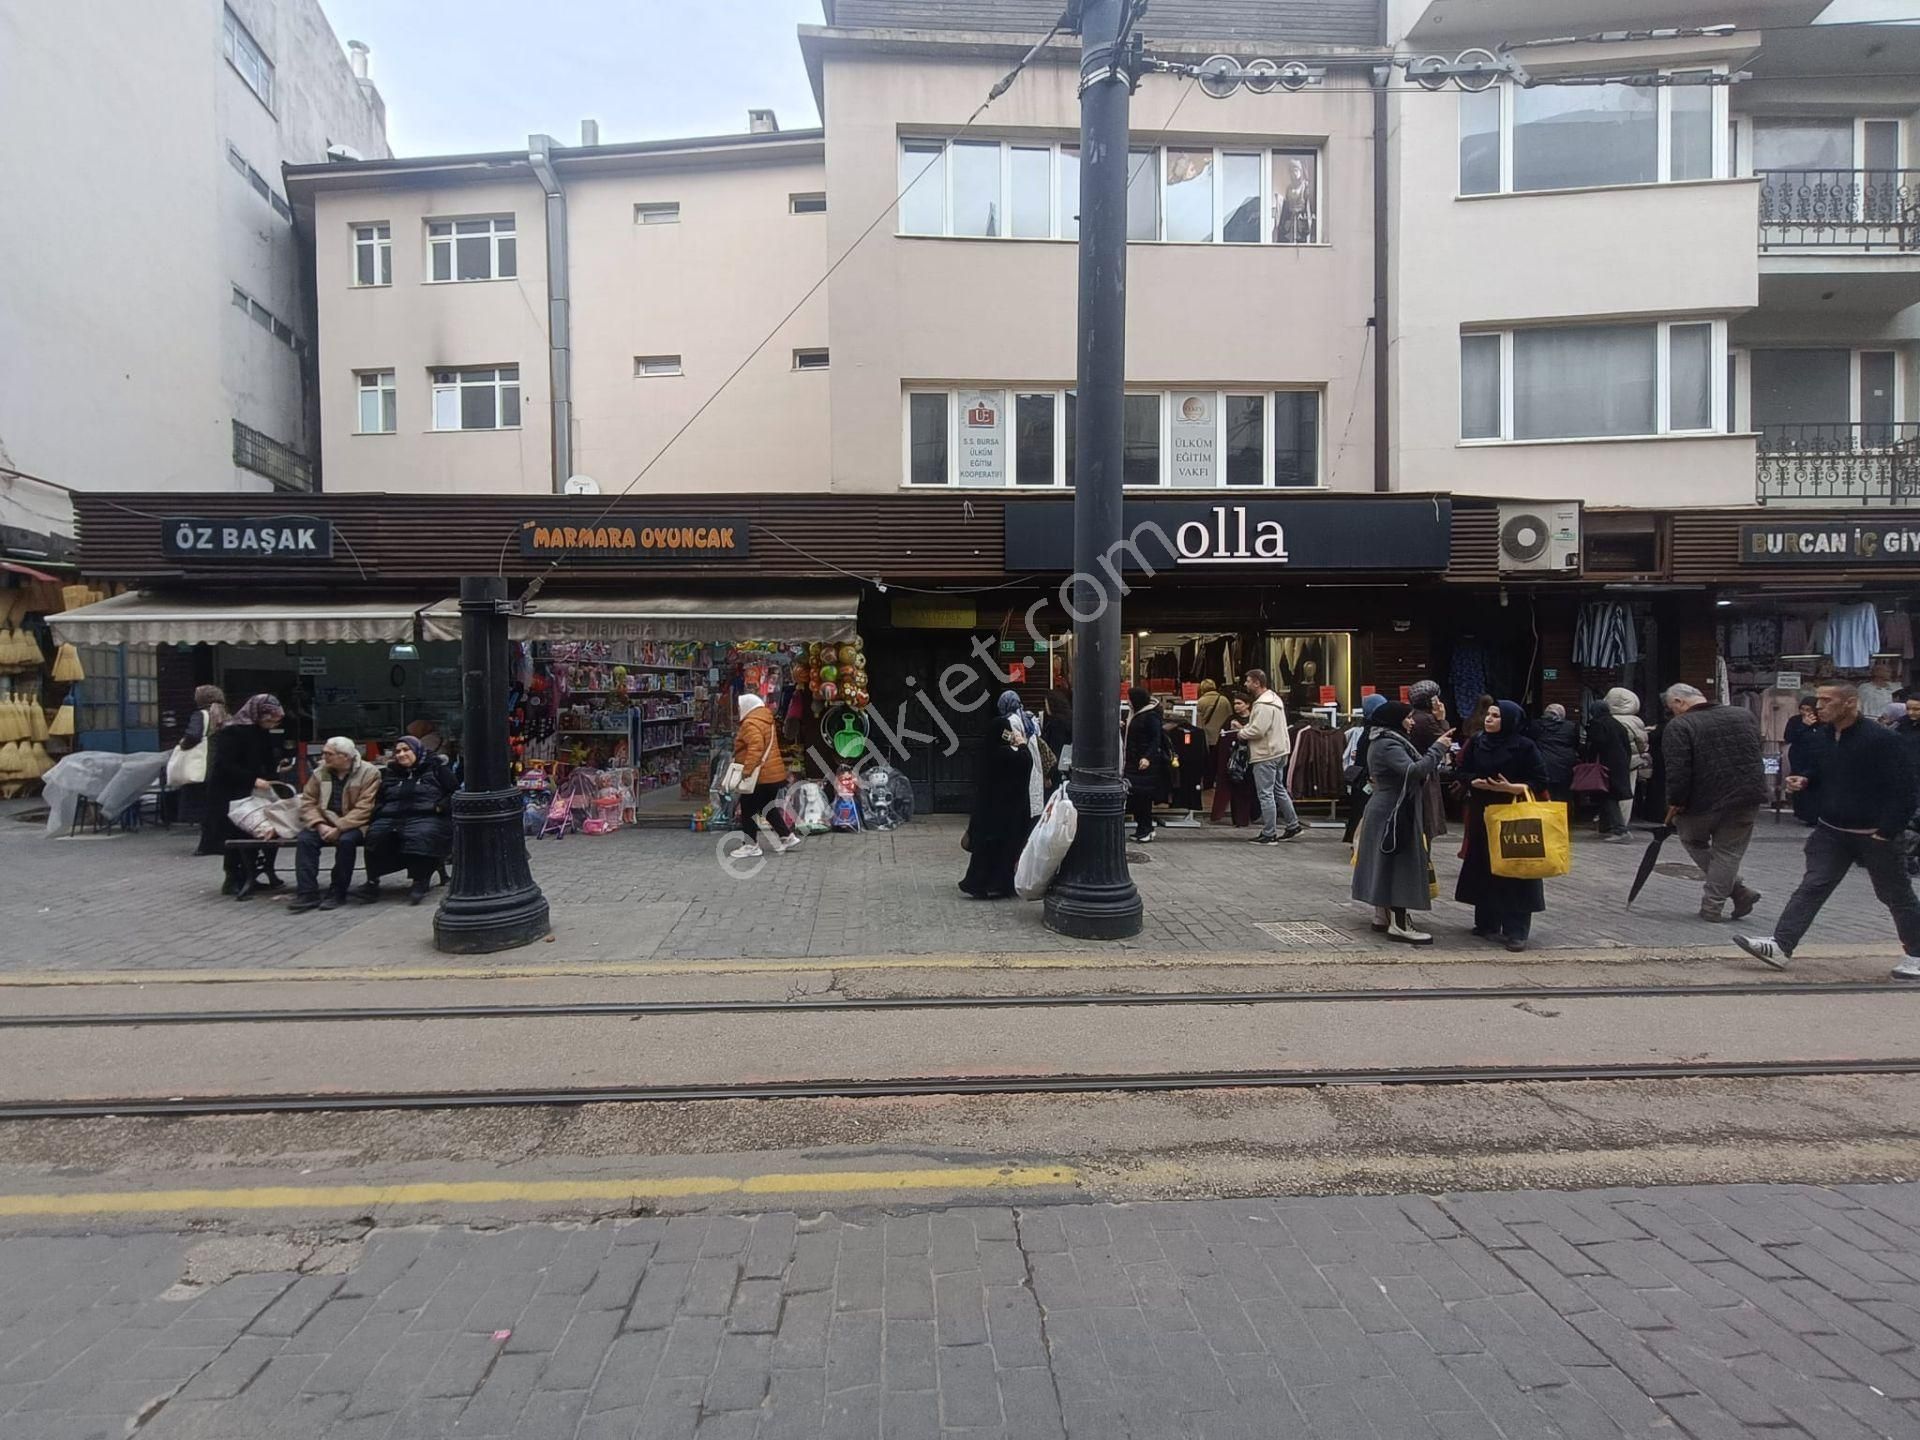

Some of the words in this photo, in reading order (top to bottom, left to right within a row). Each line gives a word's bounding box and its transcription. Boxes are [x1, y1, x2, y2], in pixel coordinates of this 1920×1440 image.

[1175, 438, 1212, 448] ÜLKÜM
[970, 447, 993, 456] ÜLKÜM
[1176, 452, 1211, 463] EĞİTİM
[970, 458, 992, 467] EĞİTİM
[1179, 468, 1208, 476] VAKFI
[533, 527, 636, 548] MARMARA
[641, 527, 734, 548] OYUNCAK
[1176, 506, 1289, 557] olla
[176, 523, 213, 549] ÖZ
[222, 529, 315, 554] BAŞAK
[1752, 533, 1846, 553] BURCAN
[1854, 528, 1877, 557] İÇ
[586, 623, 657, 636] Marmara
